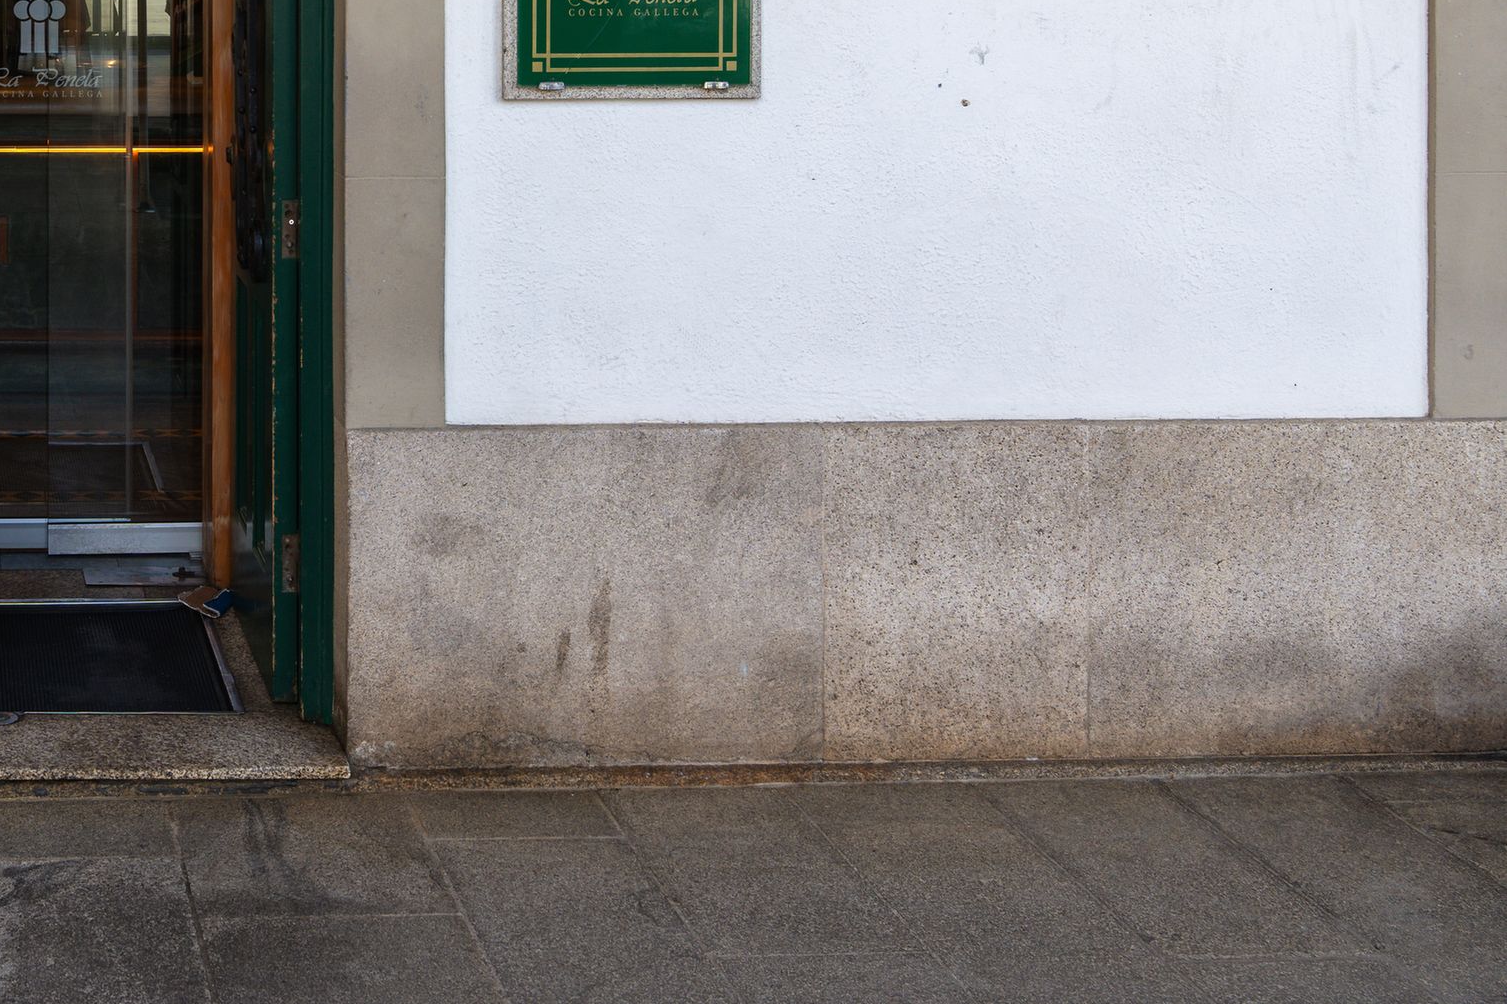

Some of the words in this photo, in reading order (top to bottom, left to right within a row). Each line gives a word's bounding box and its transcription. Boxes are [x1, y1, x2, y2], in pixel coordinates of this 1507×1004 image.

[568, 7, 624, 18] COCINA
[633, 7, 700, 17] GALLEGA
[32, 66, 103, 88] Penela
[42, 89, 103, 98] GALLEGA
